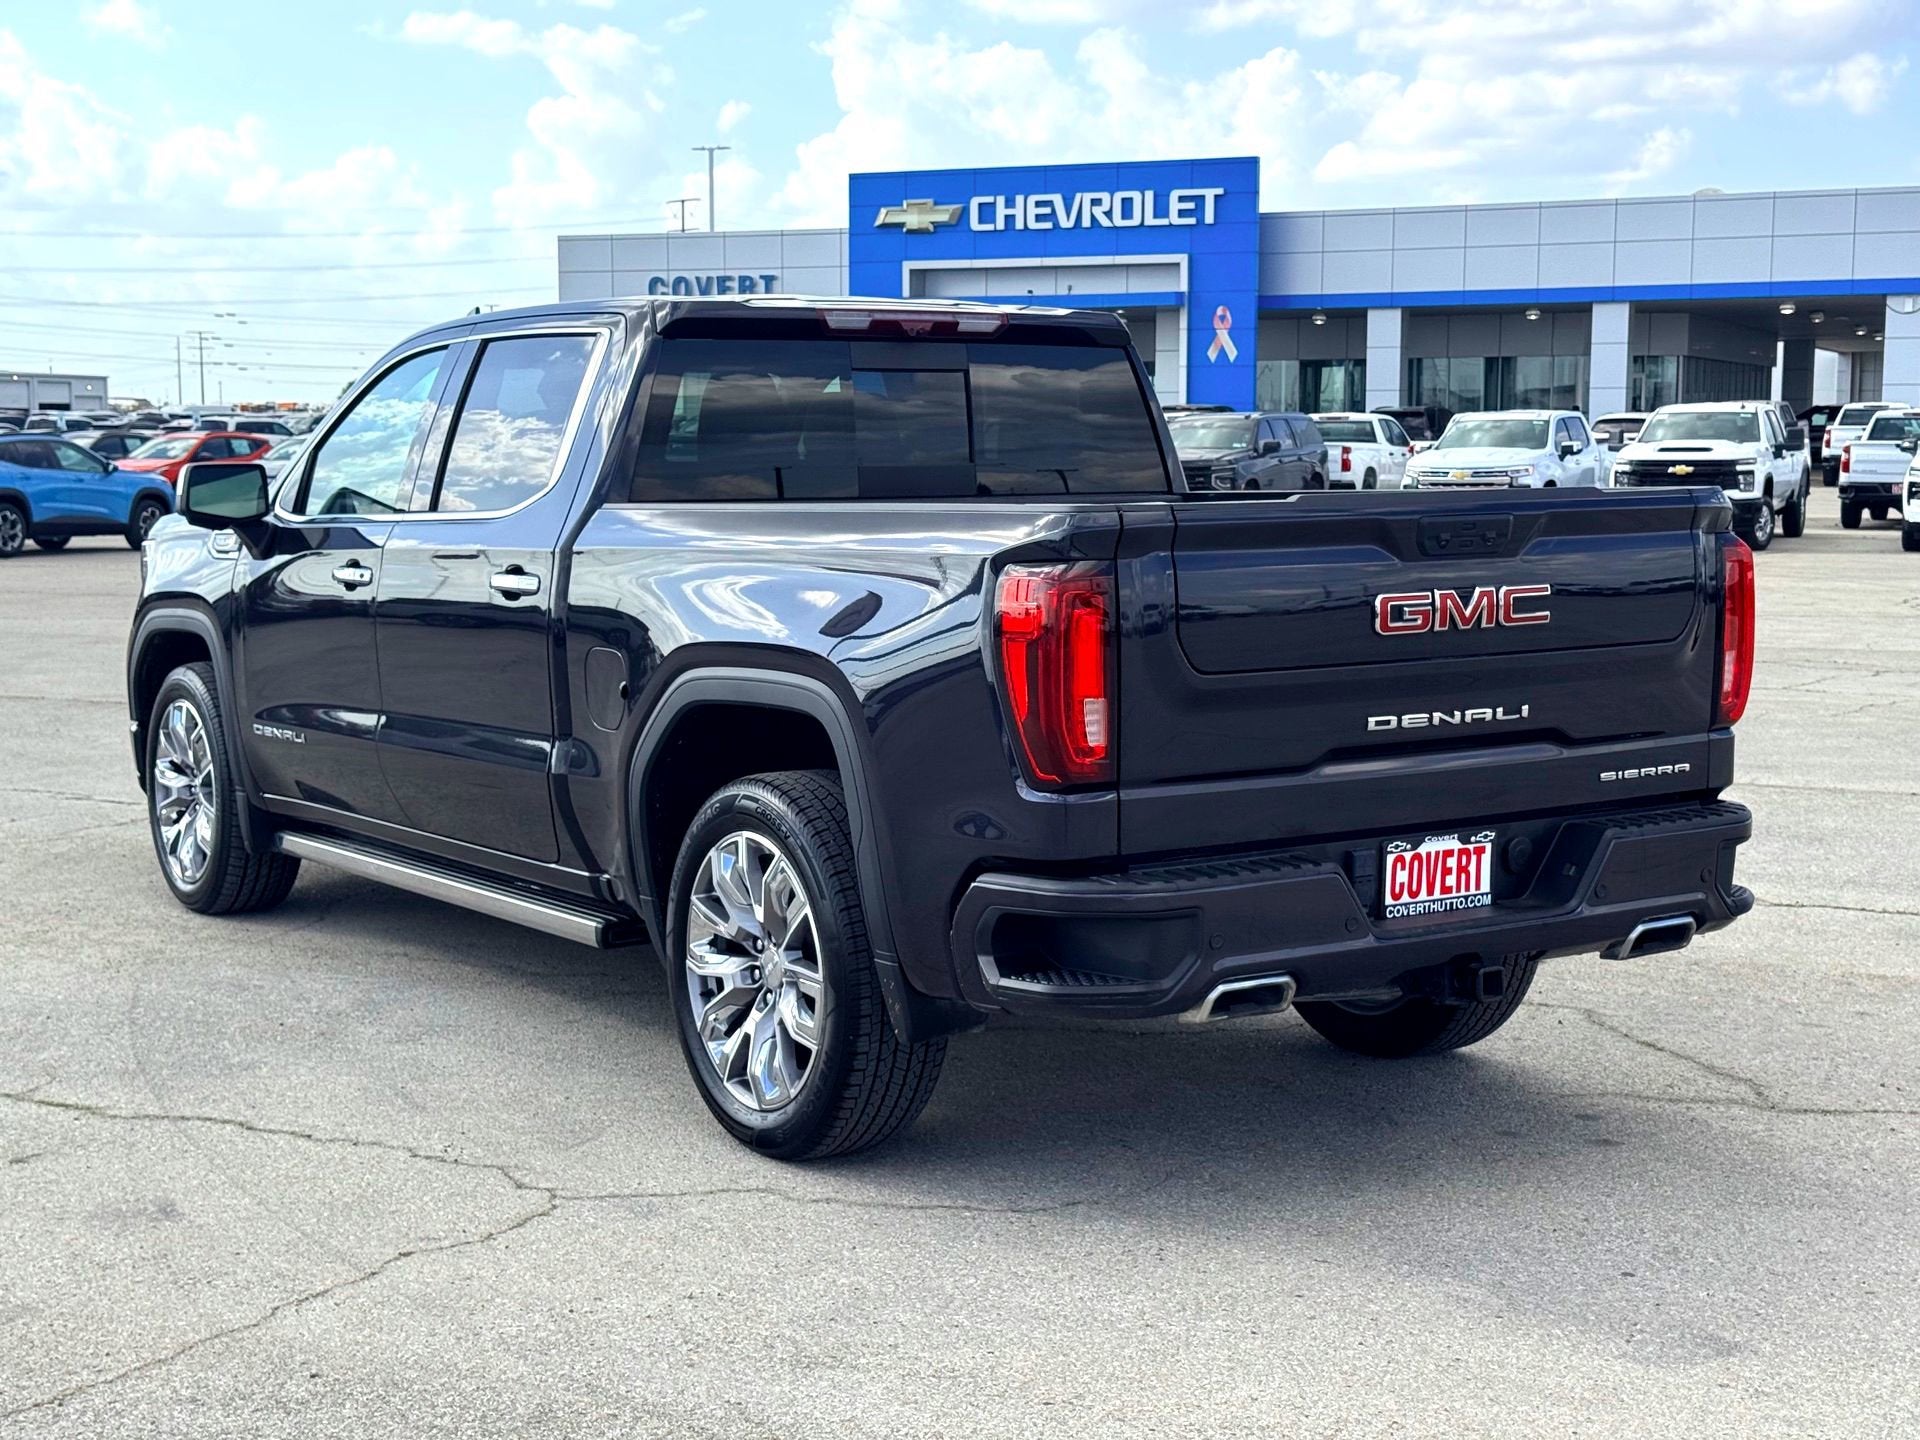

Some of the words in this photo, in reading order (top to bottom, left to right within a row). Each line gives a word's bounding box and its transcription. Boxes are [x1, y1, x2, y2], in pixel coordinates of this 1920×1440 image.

[969, 187, 1224, 231] CHEVROLET
[648, 275, 778, 296] COVERT
[1374, 584, 1551, 636] GMC
[1367, 704, 1529, 731] DENALI
[252, 723, 306, 744] DENALI
[1599, 763, 1691, 782] SIERRA
[1424, 833, 1459, 843] Covert
[1389, 845, 1486, 902] COVERT
[1386, 893, 1492, 919] COVERTHUTTO.COM
